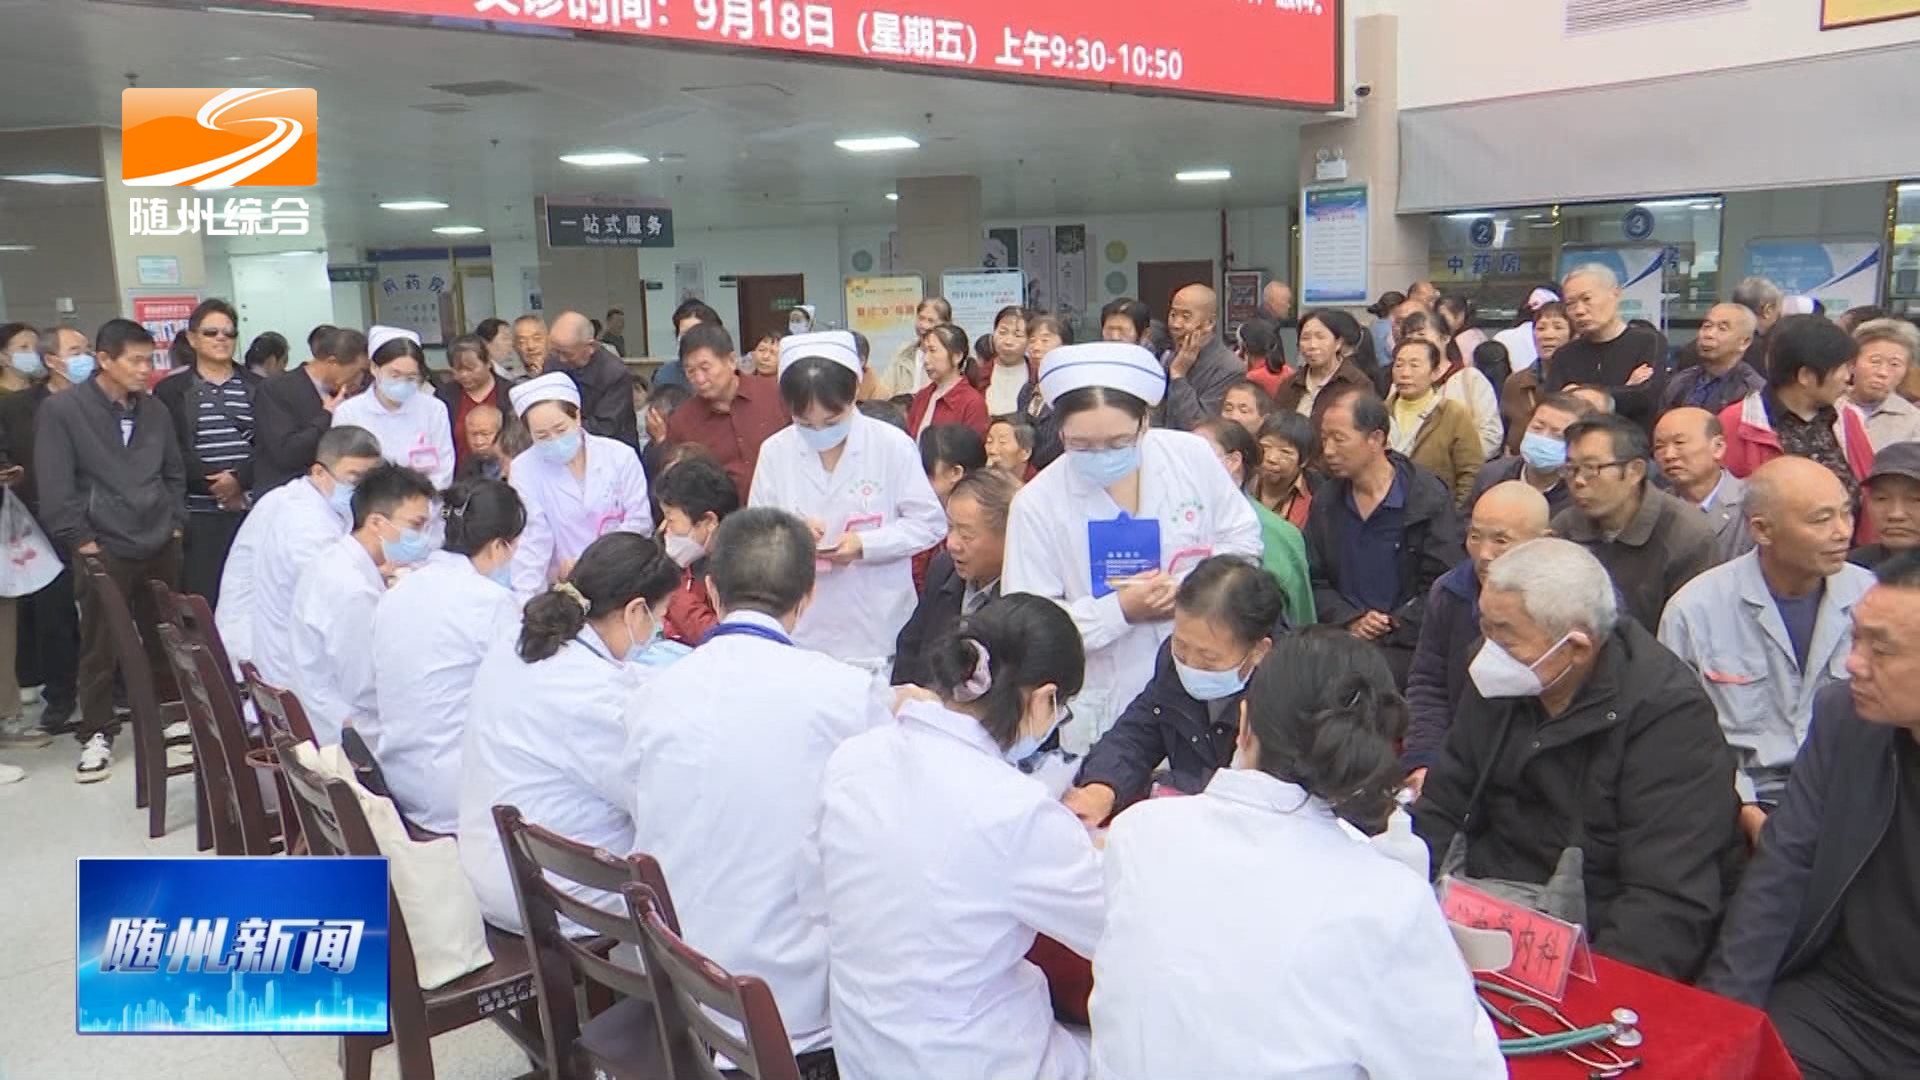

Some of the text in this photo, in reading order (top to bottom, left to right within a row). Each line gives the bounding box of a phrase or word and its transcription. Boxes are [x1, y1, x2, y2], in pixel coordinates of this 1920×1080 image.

[559, 213, 663, 237] 一站式服务
